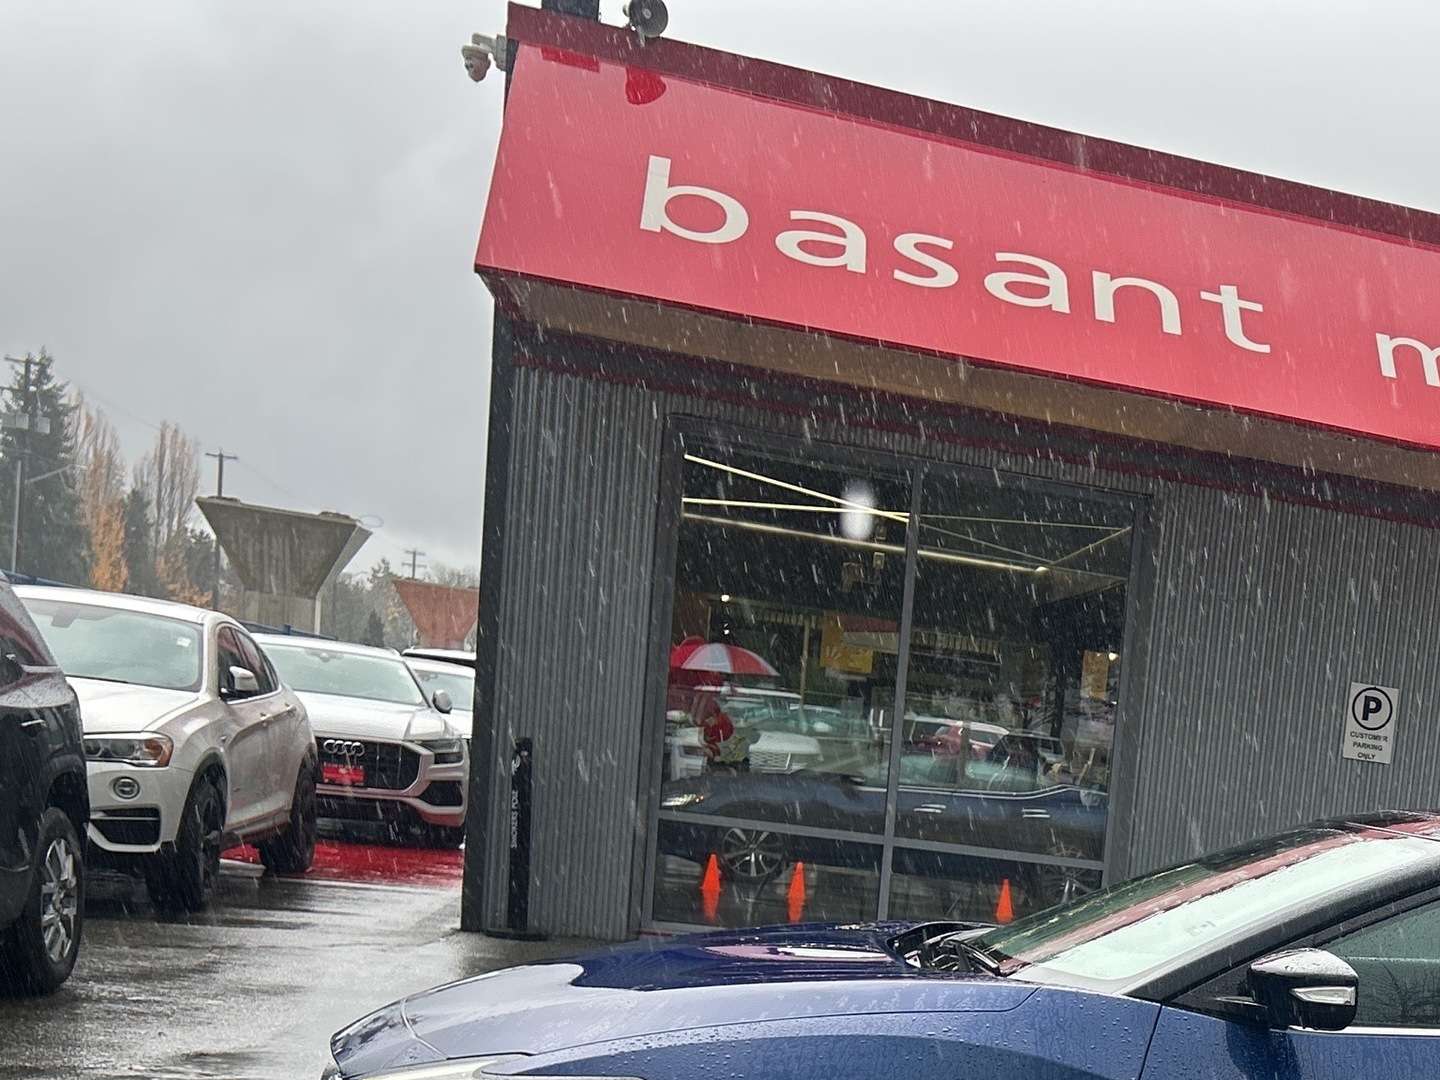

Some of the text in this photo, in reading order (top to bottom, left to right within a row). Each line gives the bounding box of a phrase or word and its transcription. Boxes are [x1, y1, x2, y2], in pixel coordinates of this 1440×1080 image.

[640, 155, 1271, 353] basant
[1362, 695, 1383, 720] P
[1350, 731, 1388, 742] CUSTOMER
[1353, 742, 1383, 751] PARKING
[1357, 752, 1376, 760] ONLY
